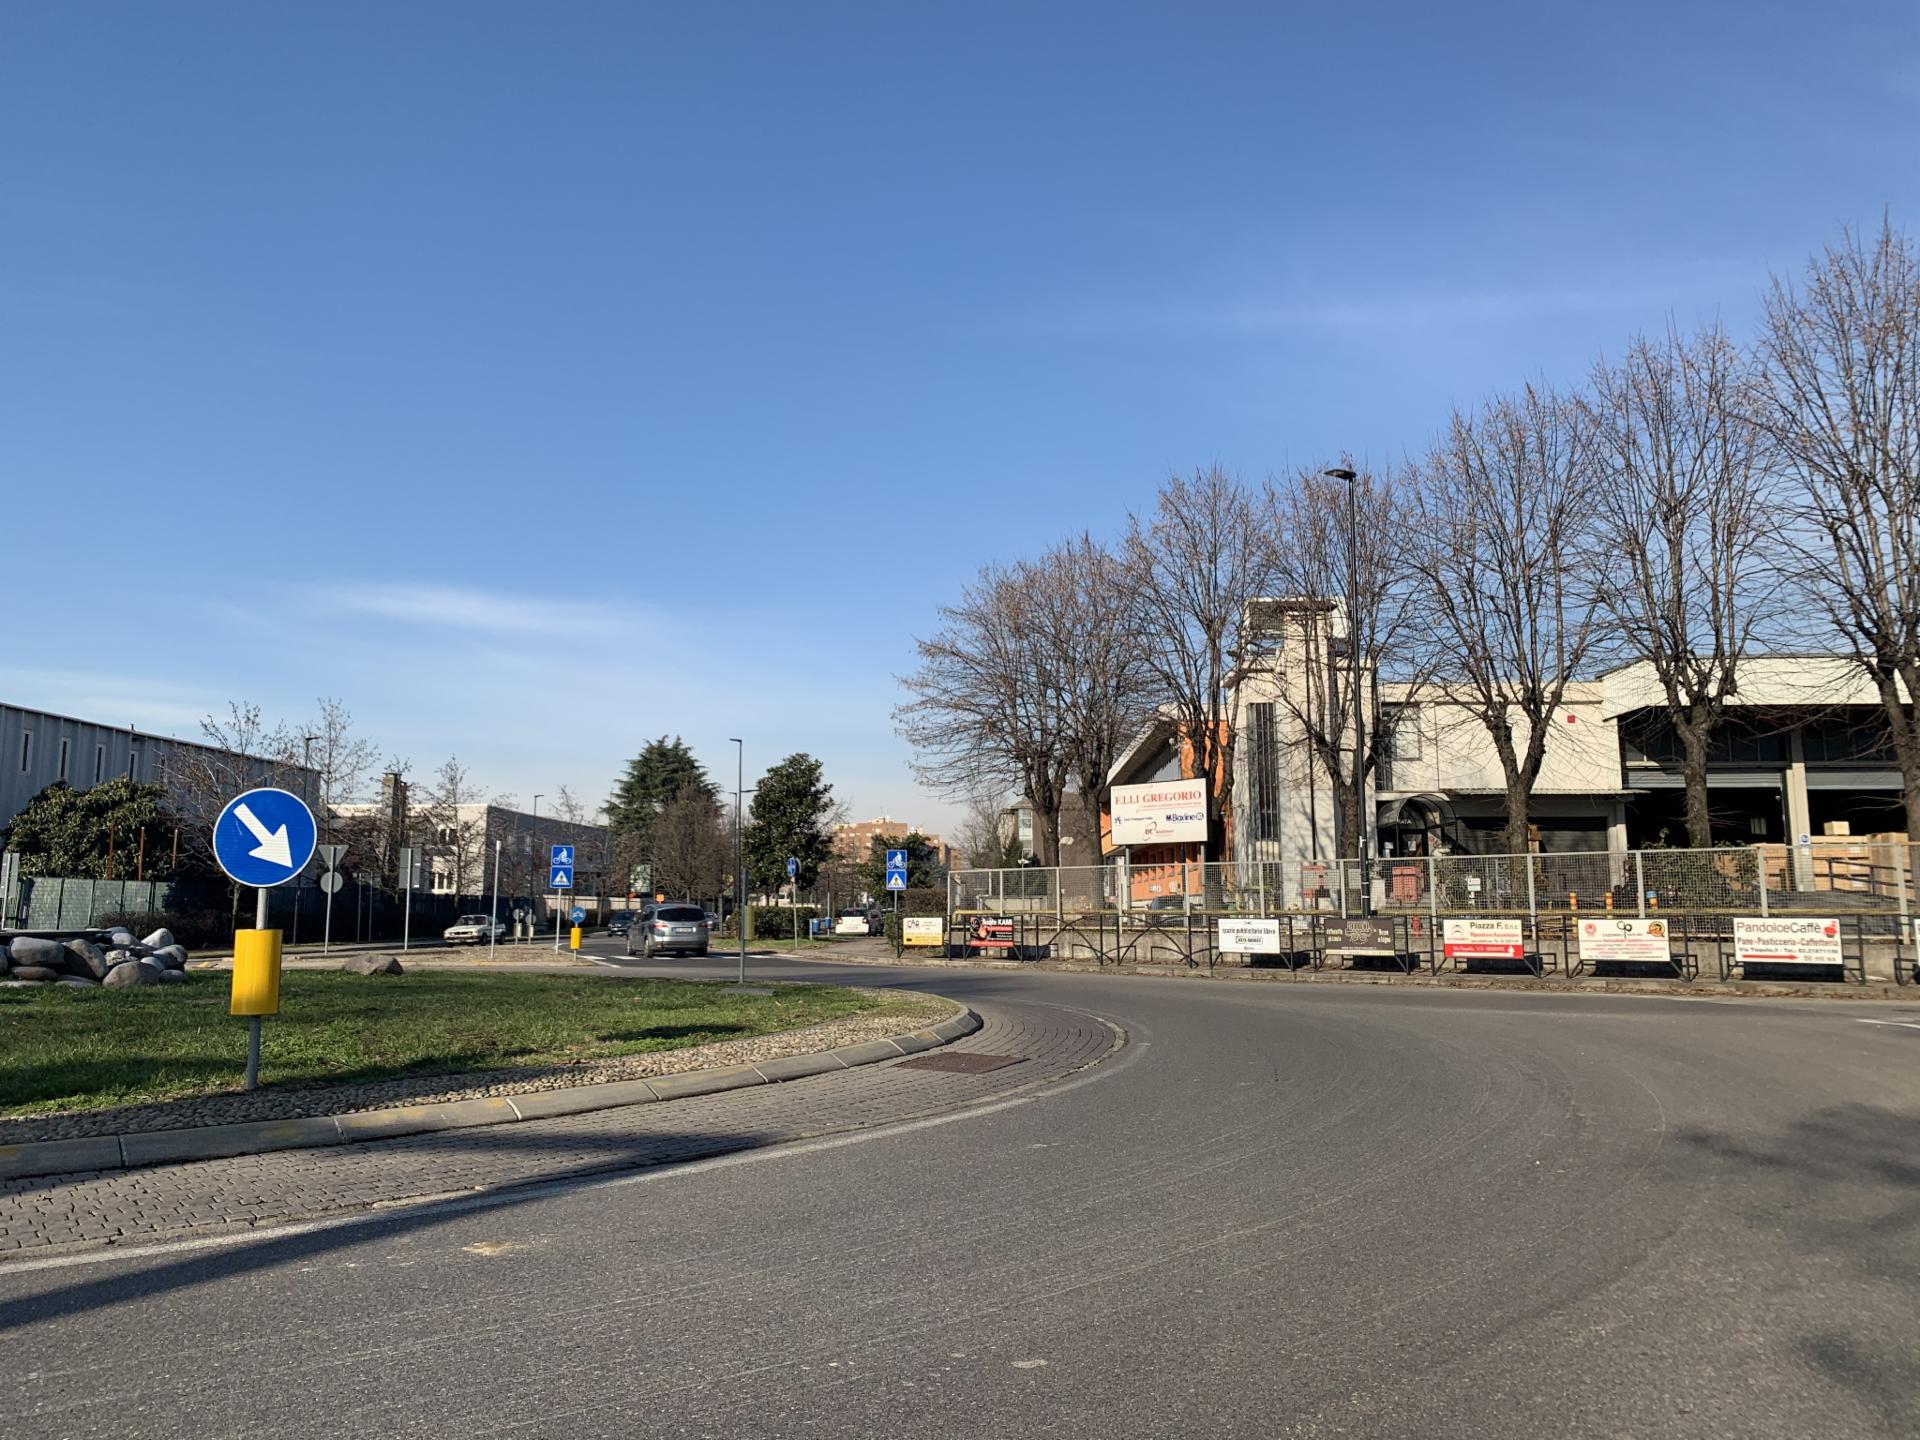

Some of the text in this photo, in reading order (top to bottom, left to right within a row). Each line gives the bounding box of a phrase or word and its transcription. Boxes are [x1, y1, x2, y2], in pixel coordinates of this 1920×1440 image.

[1142, 790, 1202, 803] GREGORIO
[1470, 921, 1495, 930] Piazza
[1736, 921, 1821, 934] PandolceCaffè
